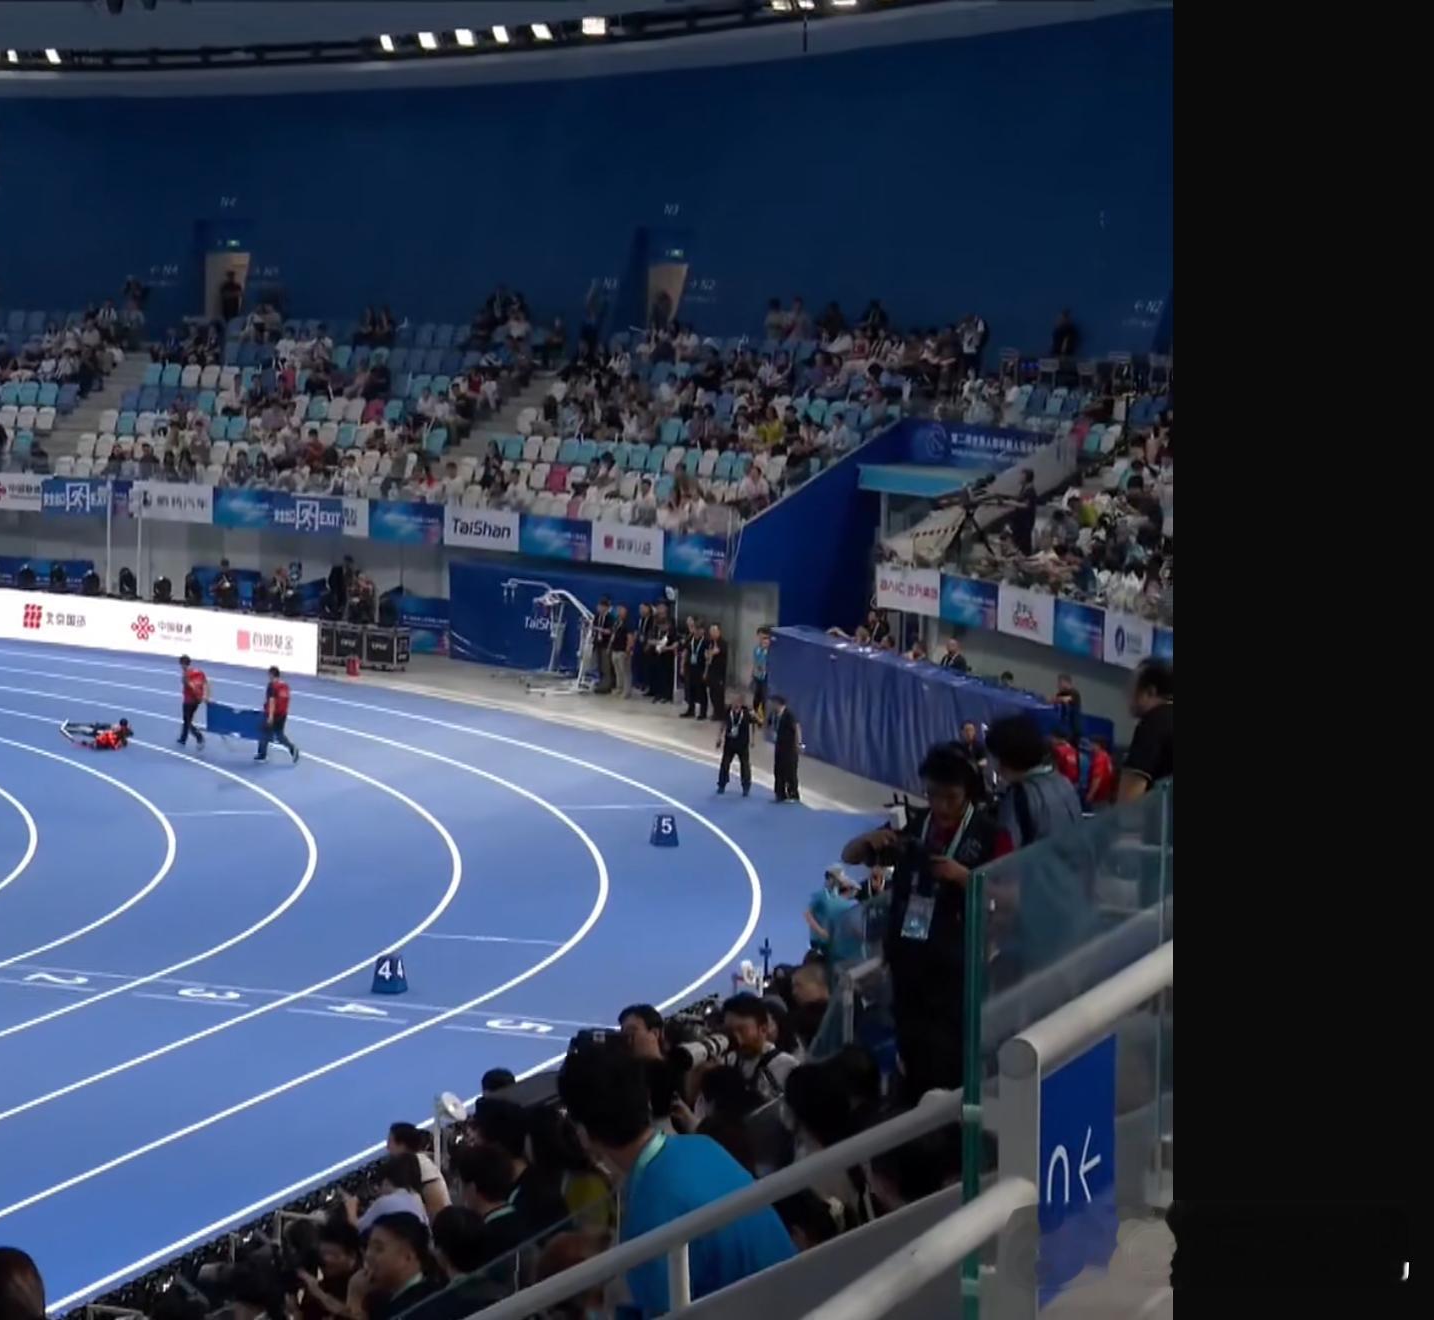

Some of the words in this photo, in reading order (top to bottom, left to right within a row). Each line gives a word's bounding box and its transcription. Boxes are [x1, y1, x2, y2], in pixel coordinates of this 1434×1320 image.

[319, 511, 341, 527] EXIT
[452, 518, 511, 540] TaiShan
[525, 615, 566, 632] TaiSh
[661, 817, 673, 835] 5
[377, 959, 393, 980] 4
[23, 972, 89, 985] 2
[177, 985, 242, 1000] 3
[326, 1002, 389, 1017] 4
[484, 1017, 555, 1035] 5
